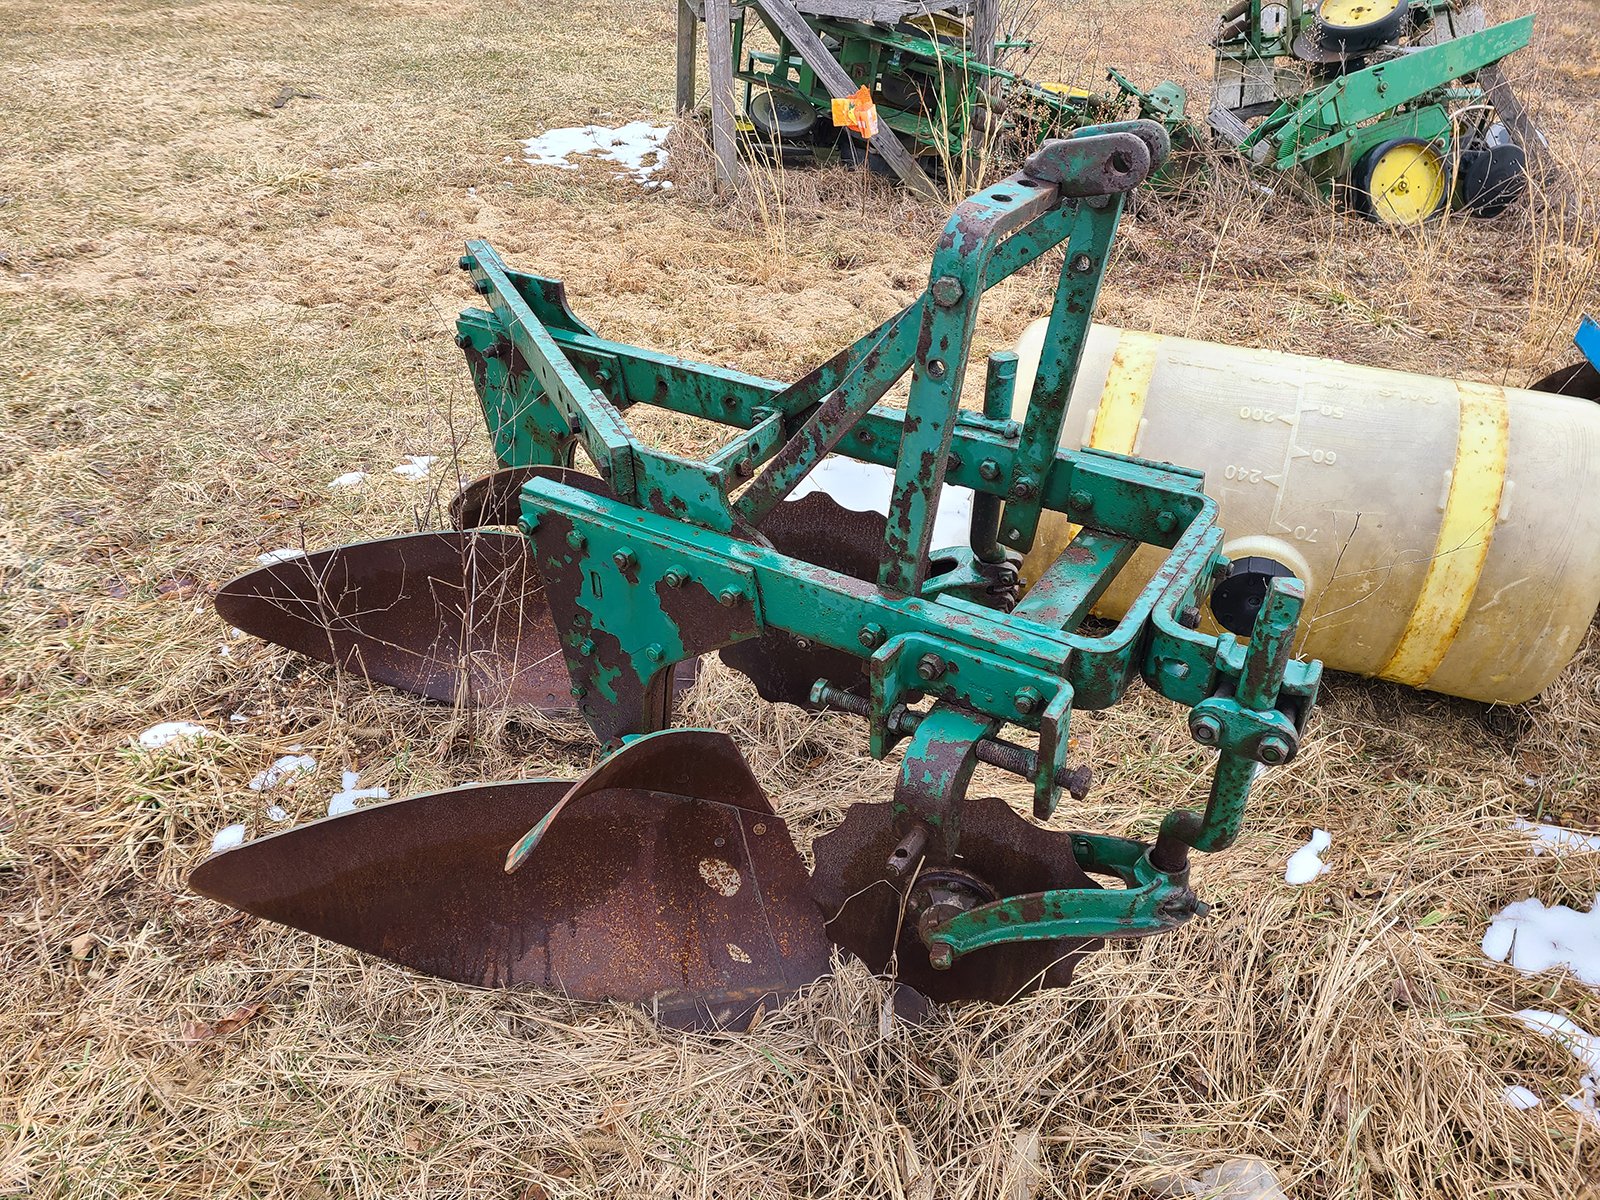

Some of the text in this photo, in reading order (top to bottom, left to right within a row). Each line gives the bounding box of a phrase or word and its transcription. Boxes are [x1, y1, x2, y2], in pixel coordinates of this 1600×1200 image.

[1240, 406, 1276, 423] 200
[1320, 404, 1345, 419] 50
[1311, 449, 1337, 466] 60
[1224, 464, 1262, 484] 240
[1294, 525, 1318, 543] 70
